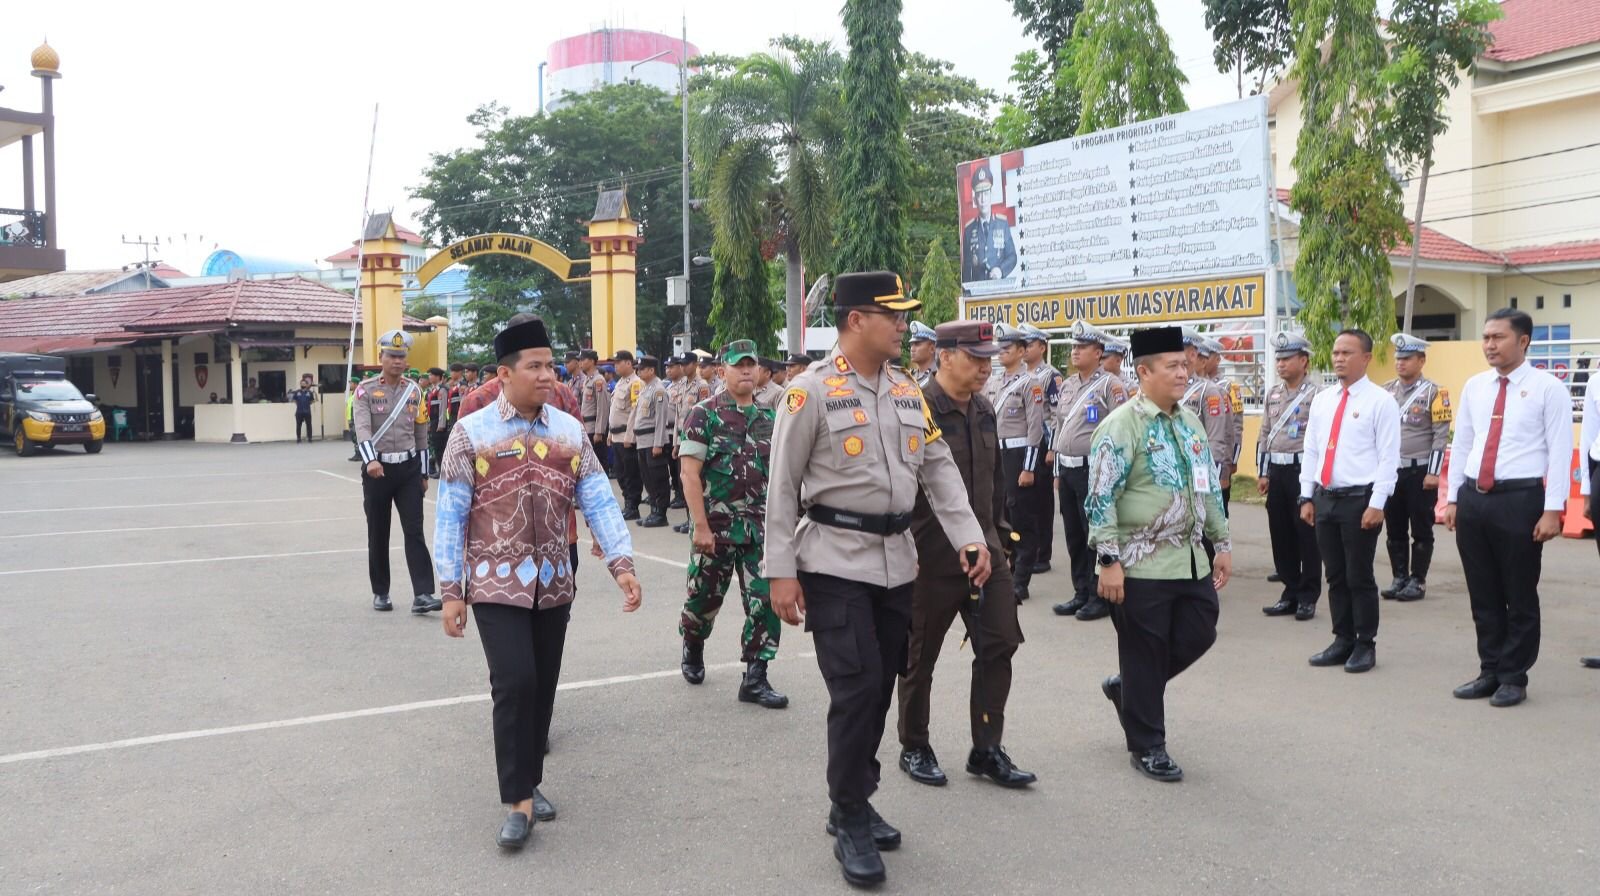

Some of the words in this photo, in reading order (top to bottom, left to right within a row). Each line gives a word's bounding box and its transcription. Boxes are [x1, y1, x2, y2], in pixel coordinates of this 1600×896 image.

[1071, 140, 1080, 151] 16
[1080, 133, 1115, 149] PROGRAM
[1116, 124, 1153, 141] PRIORITAS
[1154, 119, 1176, 133] POLRI
[450, 237, 493, 260] SELAMAT
[498, 237, 532, 255] JALAN
[970, 304, 1012, 323] HEBAT
[1016, 300, 1060, 323] SIGAP
[1064, 293, 1121, 320] UNTUK
[1126, 283, 1257, 316] MASYARAKAT
[825, 398, 862, 412] ISHARYADI
[894, 398, 922, 410] POLRI
